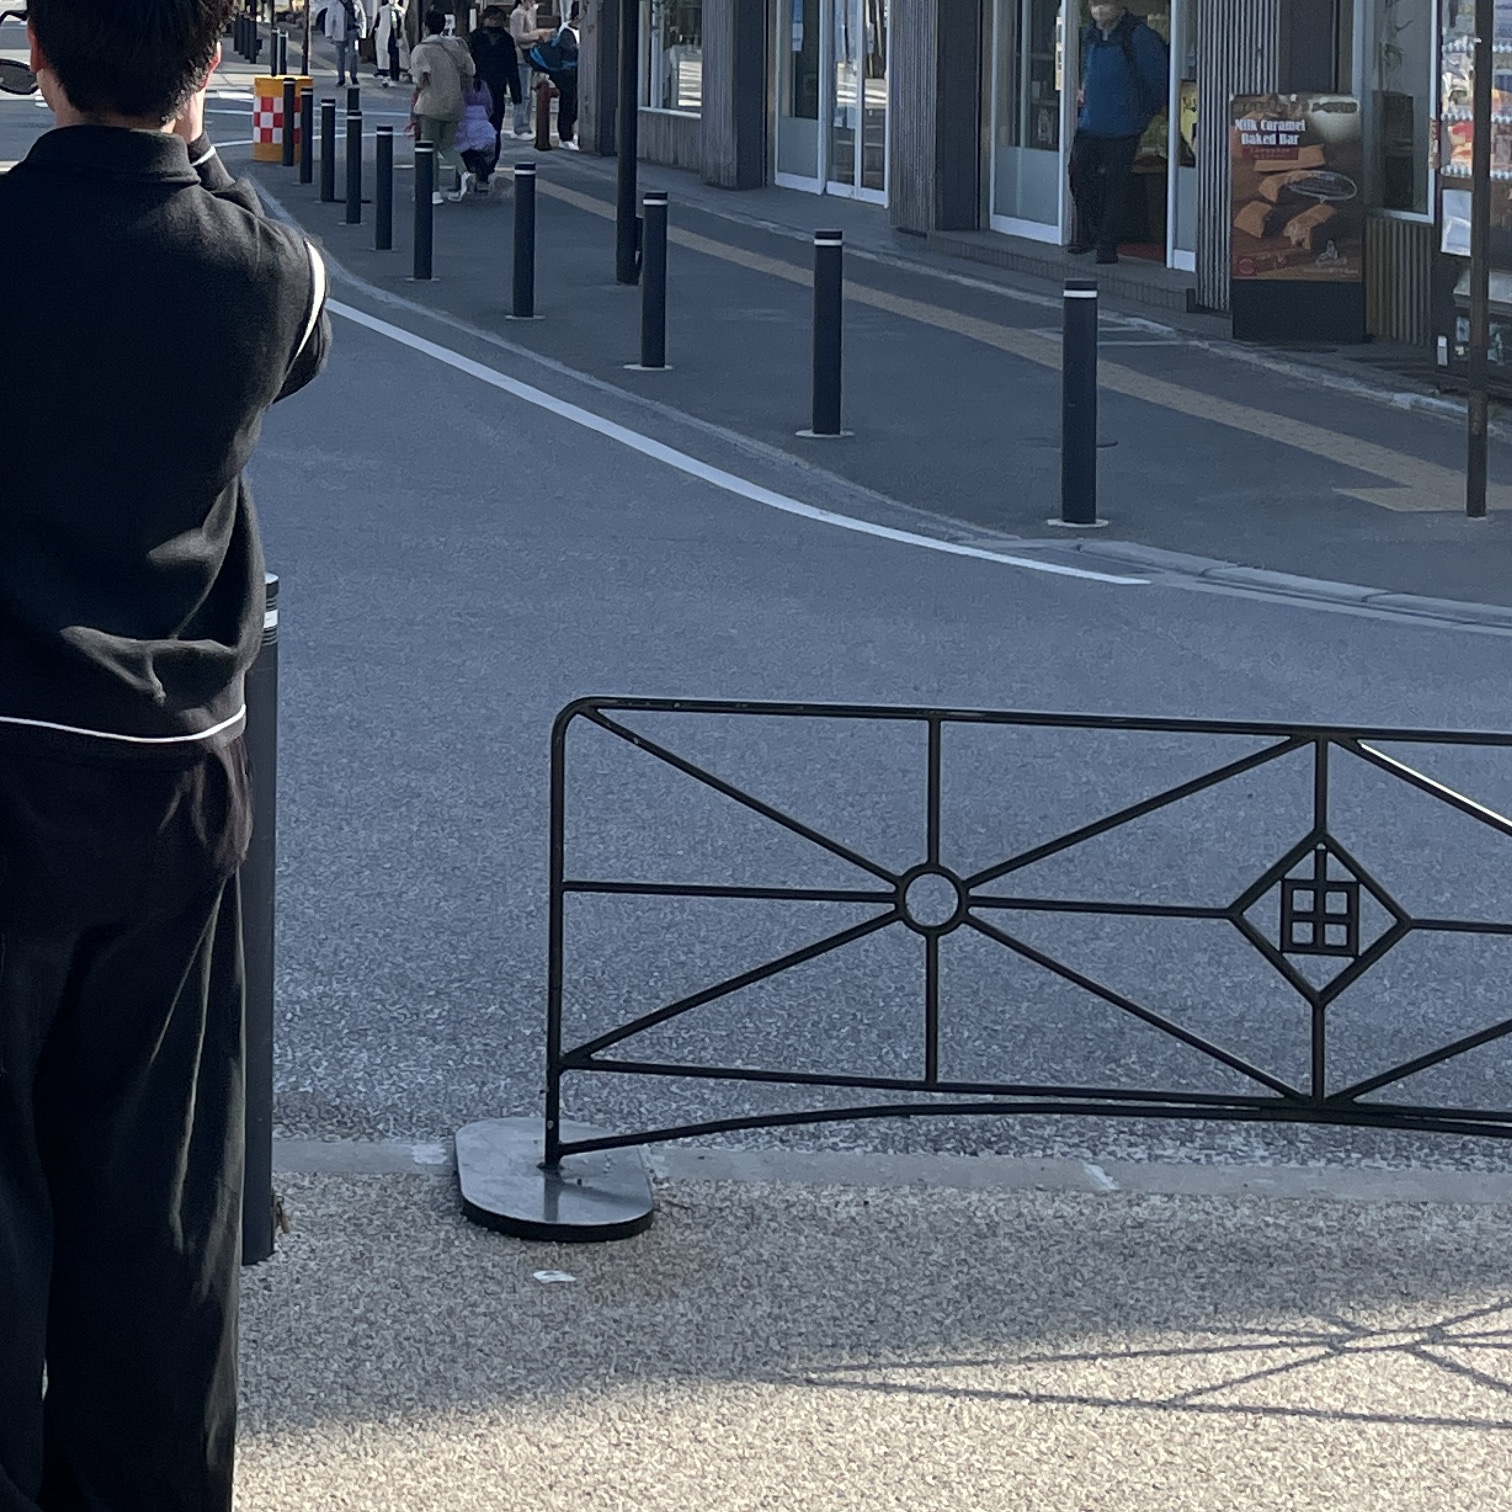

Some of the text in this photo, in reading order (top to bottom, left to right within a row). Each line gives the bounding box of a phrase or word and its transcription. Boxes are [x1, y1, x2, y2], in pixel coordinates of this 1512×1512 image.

[1235, 119, 1306, 131] Milk Caramel
[1241, 133, 1300, 145] Baked Bar
